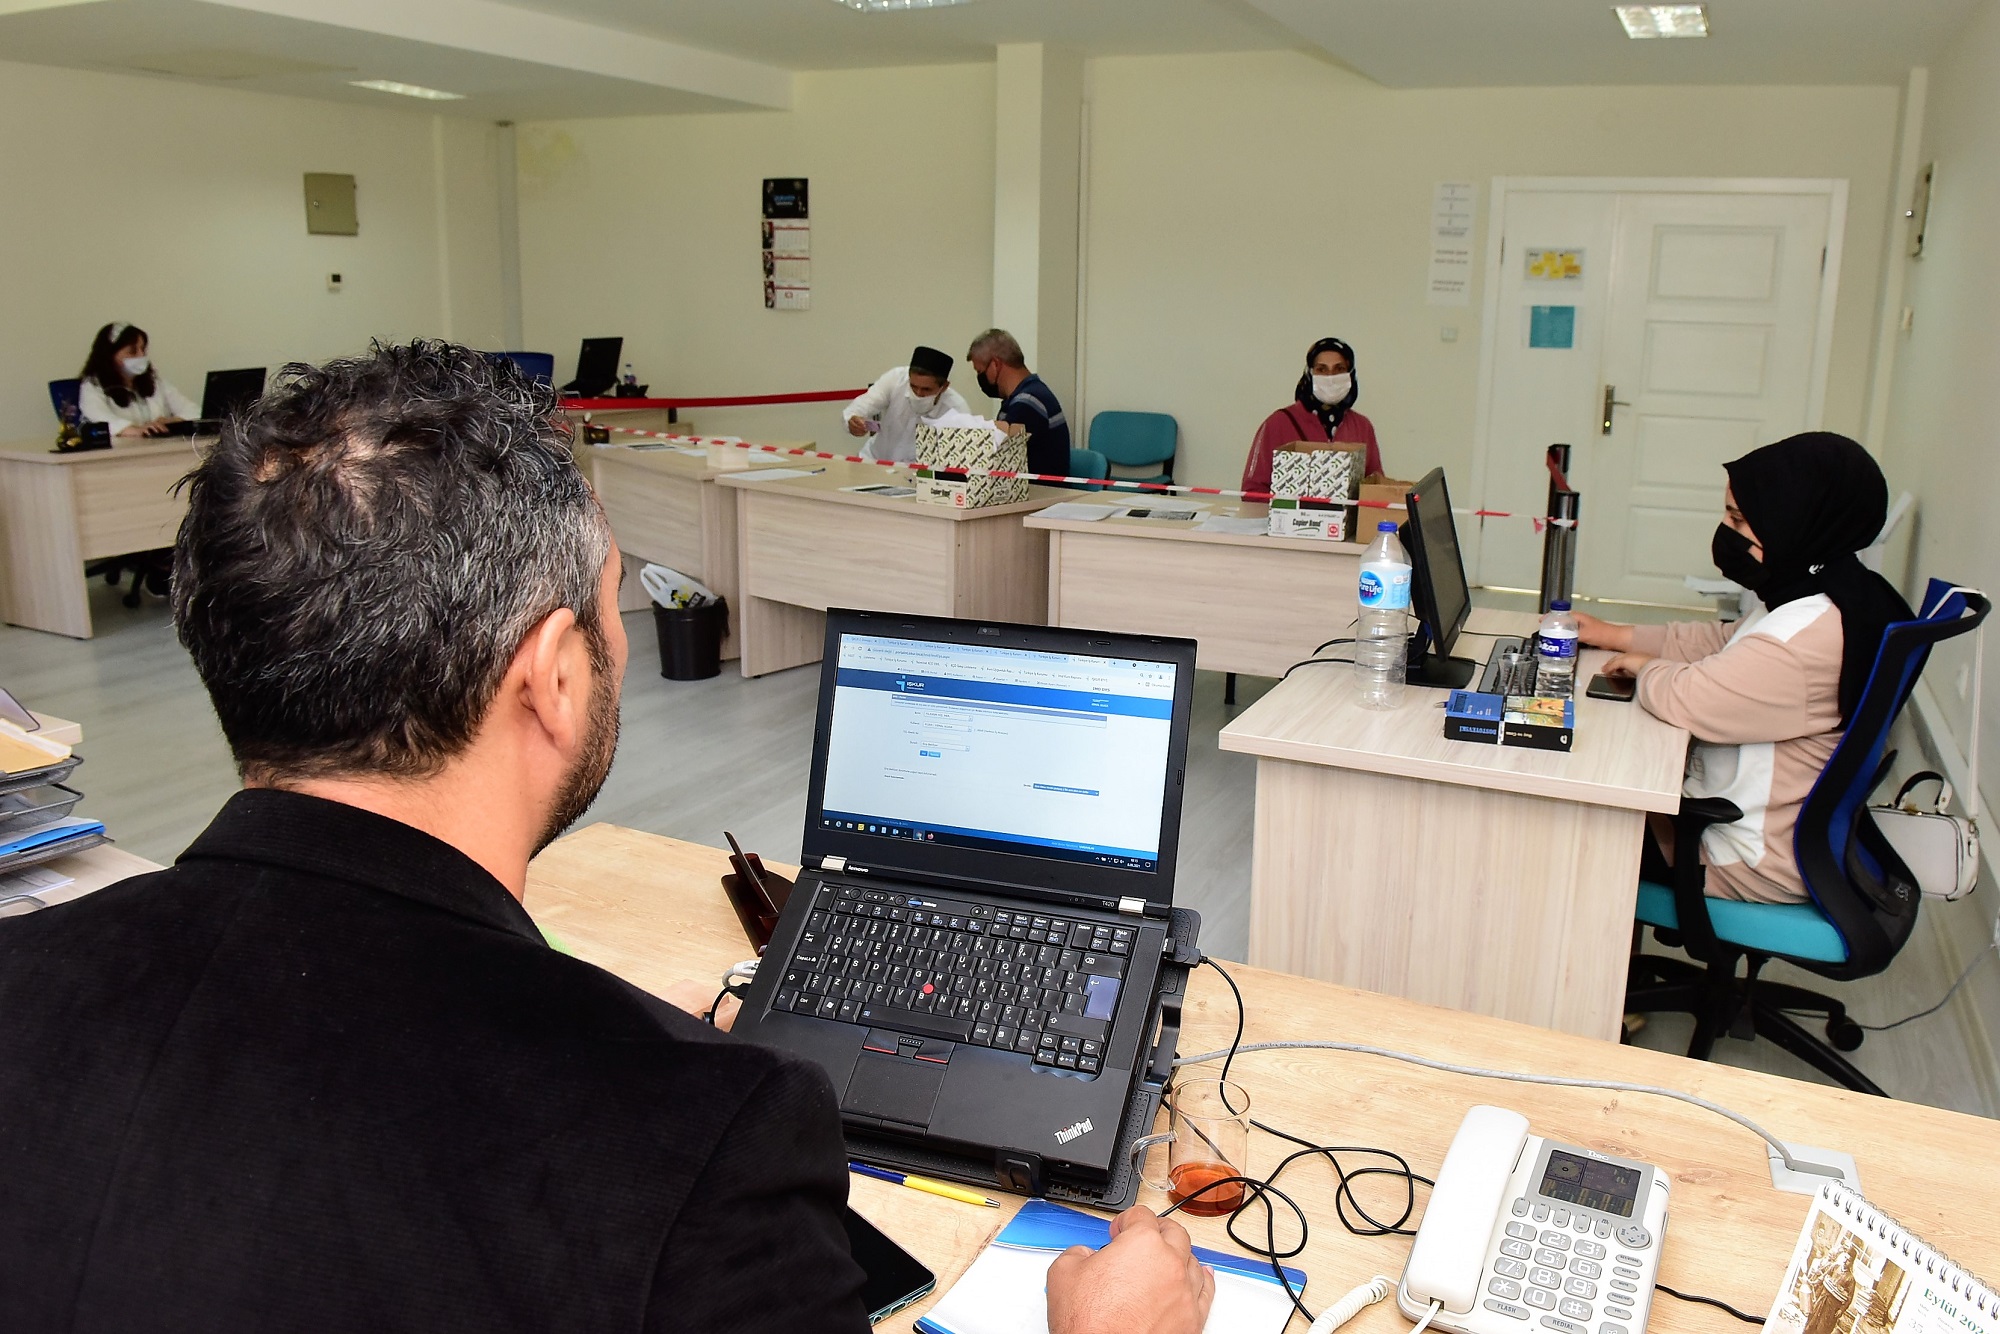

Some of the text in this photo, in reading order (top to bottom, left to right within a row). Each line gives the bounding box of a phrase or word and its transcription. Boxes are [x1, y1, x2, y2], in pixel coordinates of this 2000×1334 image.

[1293, 518, 1308, 527] Copier
[1054, 1117, 1094, 1145] ThinkPad
[1517, 1223, 1524, 1236] 1
[1548, 1232, 1560, 1245] 2
[1508, 1241, 1521, 1255] 4
[1583, 1241, 1595, 1254] 3
[1543, 1250, 1556, 1264] 5
[1504, 1260, 1516, 1272] 7
[1578, 1260, 1592, 1274] 6
[1537, 1269, 1551, 1283] 8
[1572, 1280, 1587, 1294] 9
[1532, 1290, 1546, 1304] 0
[1497, 1304, 1516, 1313] FLASH
[1924, 1288, 1991, 1334] Eylül 202
[1552, 1320, 1573, 1329] REDIAL
[1908, 1318, 1924, 1334] 35
